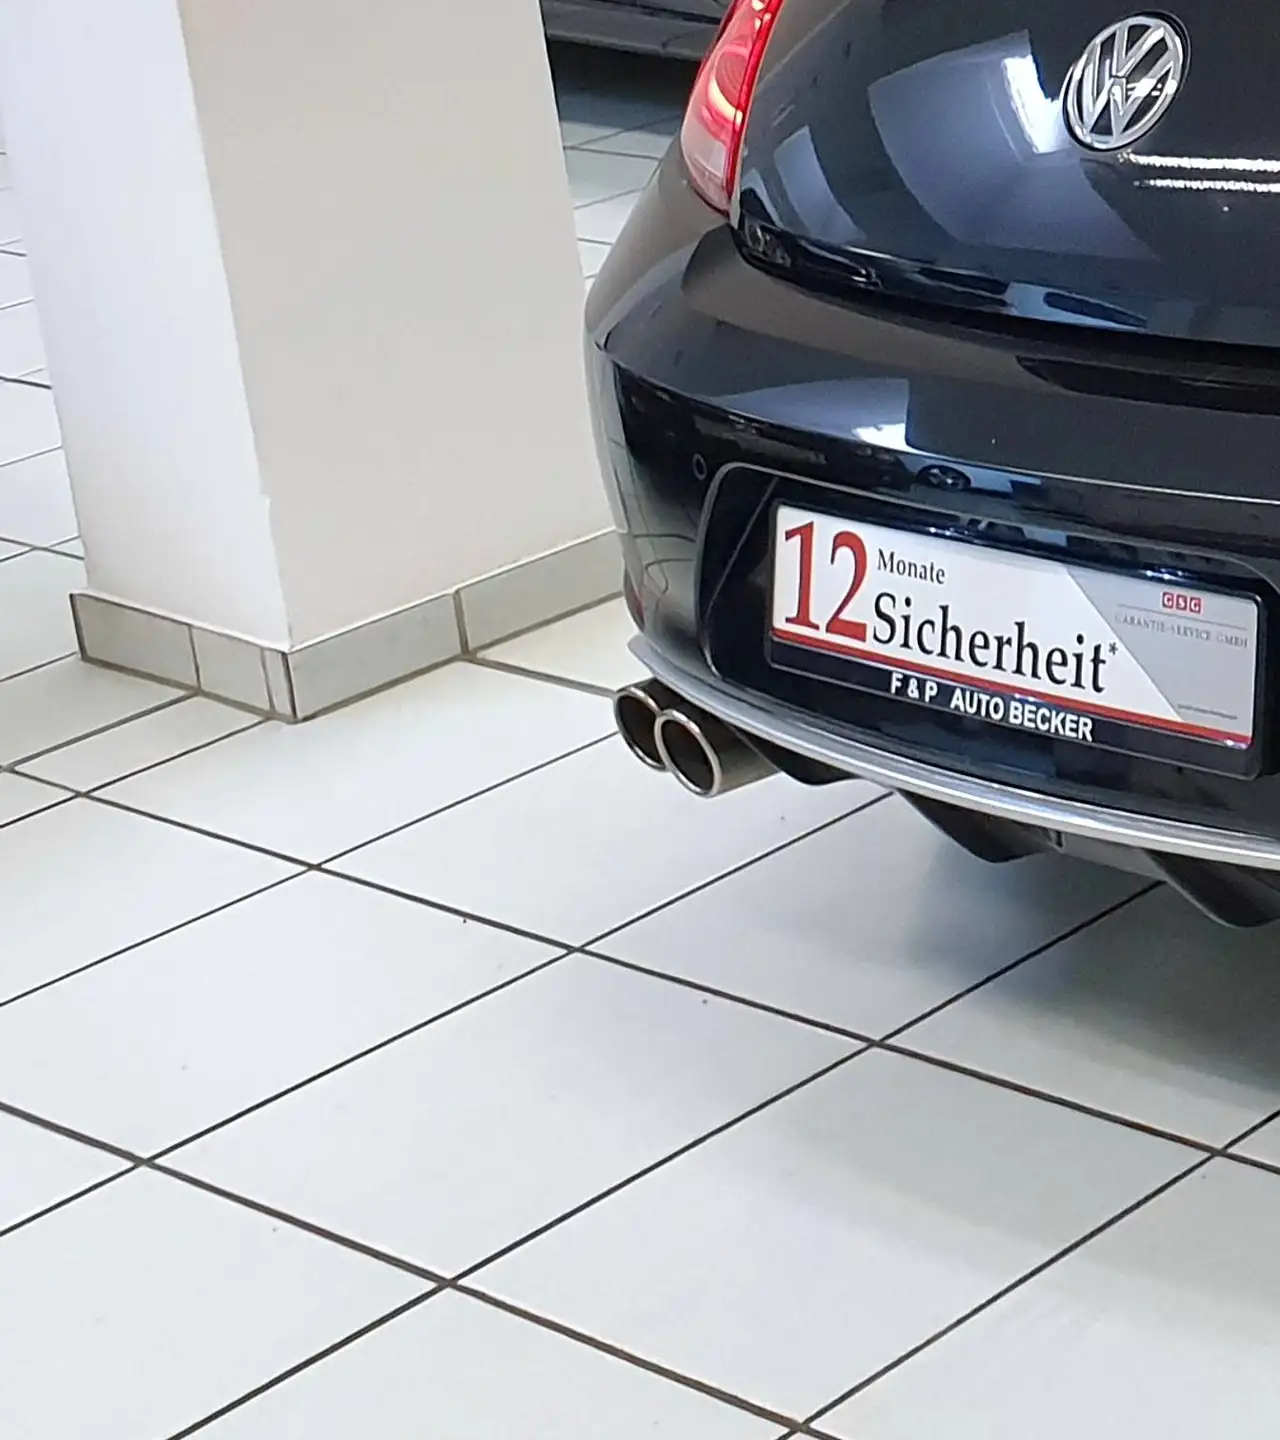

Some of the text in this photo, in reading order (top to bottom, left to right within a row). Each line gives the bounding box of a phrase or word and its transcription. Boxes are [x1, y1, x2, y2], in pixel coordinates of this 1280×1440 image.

[784, 520, 868, 643] 12
[876, 547, 947, 585] Monate
[1162, 591, 1202, 614] GSG
[890, 672, 1094, 742] F & P AUTO BECKER
